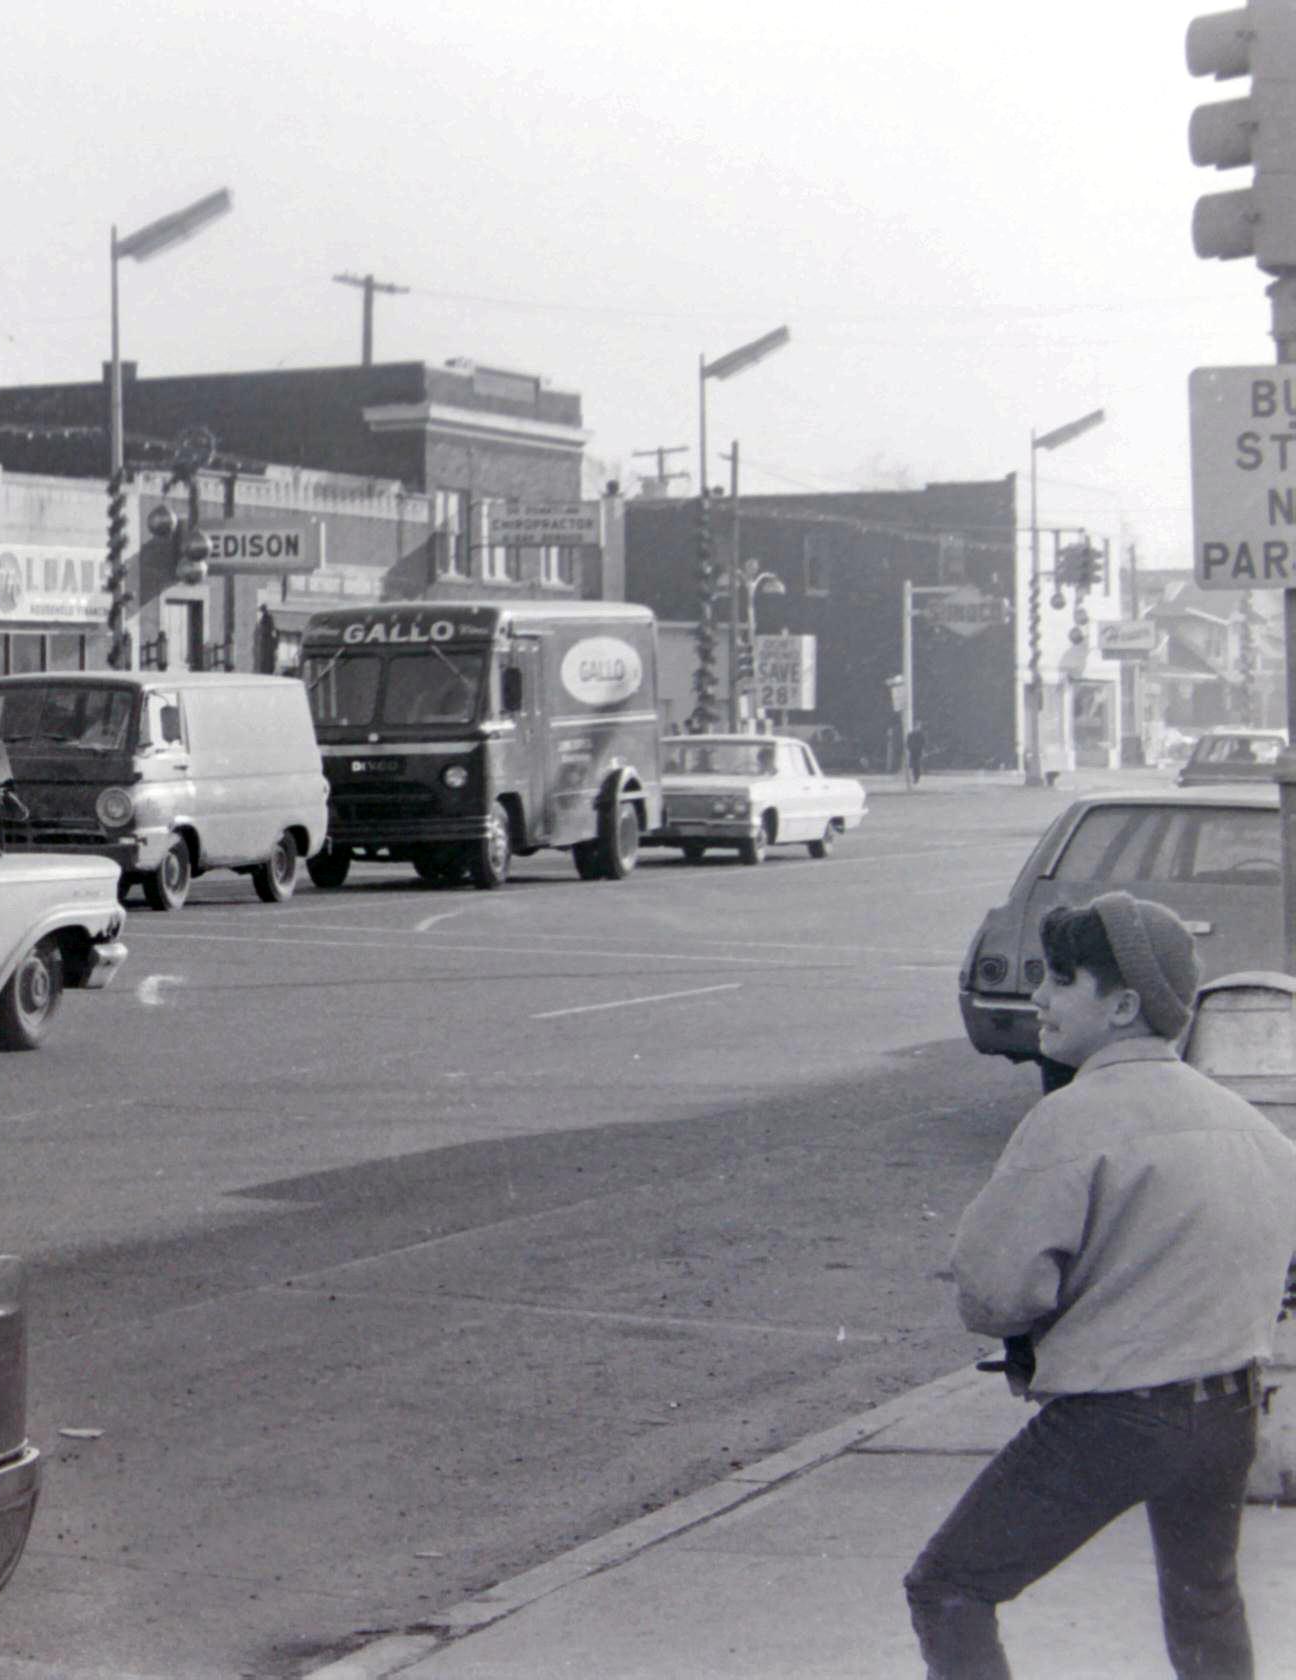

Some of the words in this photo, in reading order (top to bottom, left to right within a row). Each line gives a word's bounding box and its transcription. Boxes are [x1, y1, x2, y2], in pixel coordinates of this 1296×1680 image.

[1236, 431, 1296, 472] ST
[491, 518, 594, 532] CHIROPRACTOR
[209, 533, 299, 558] EDISON
[1203, 540, 1296, 581] PAR
[342, 619, 455, 645] GALLO
[579, 657, 625, 683] GALLO
[758, 662, 802, 684] SAVE
